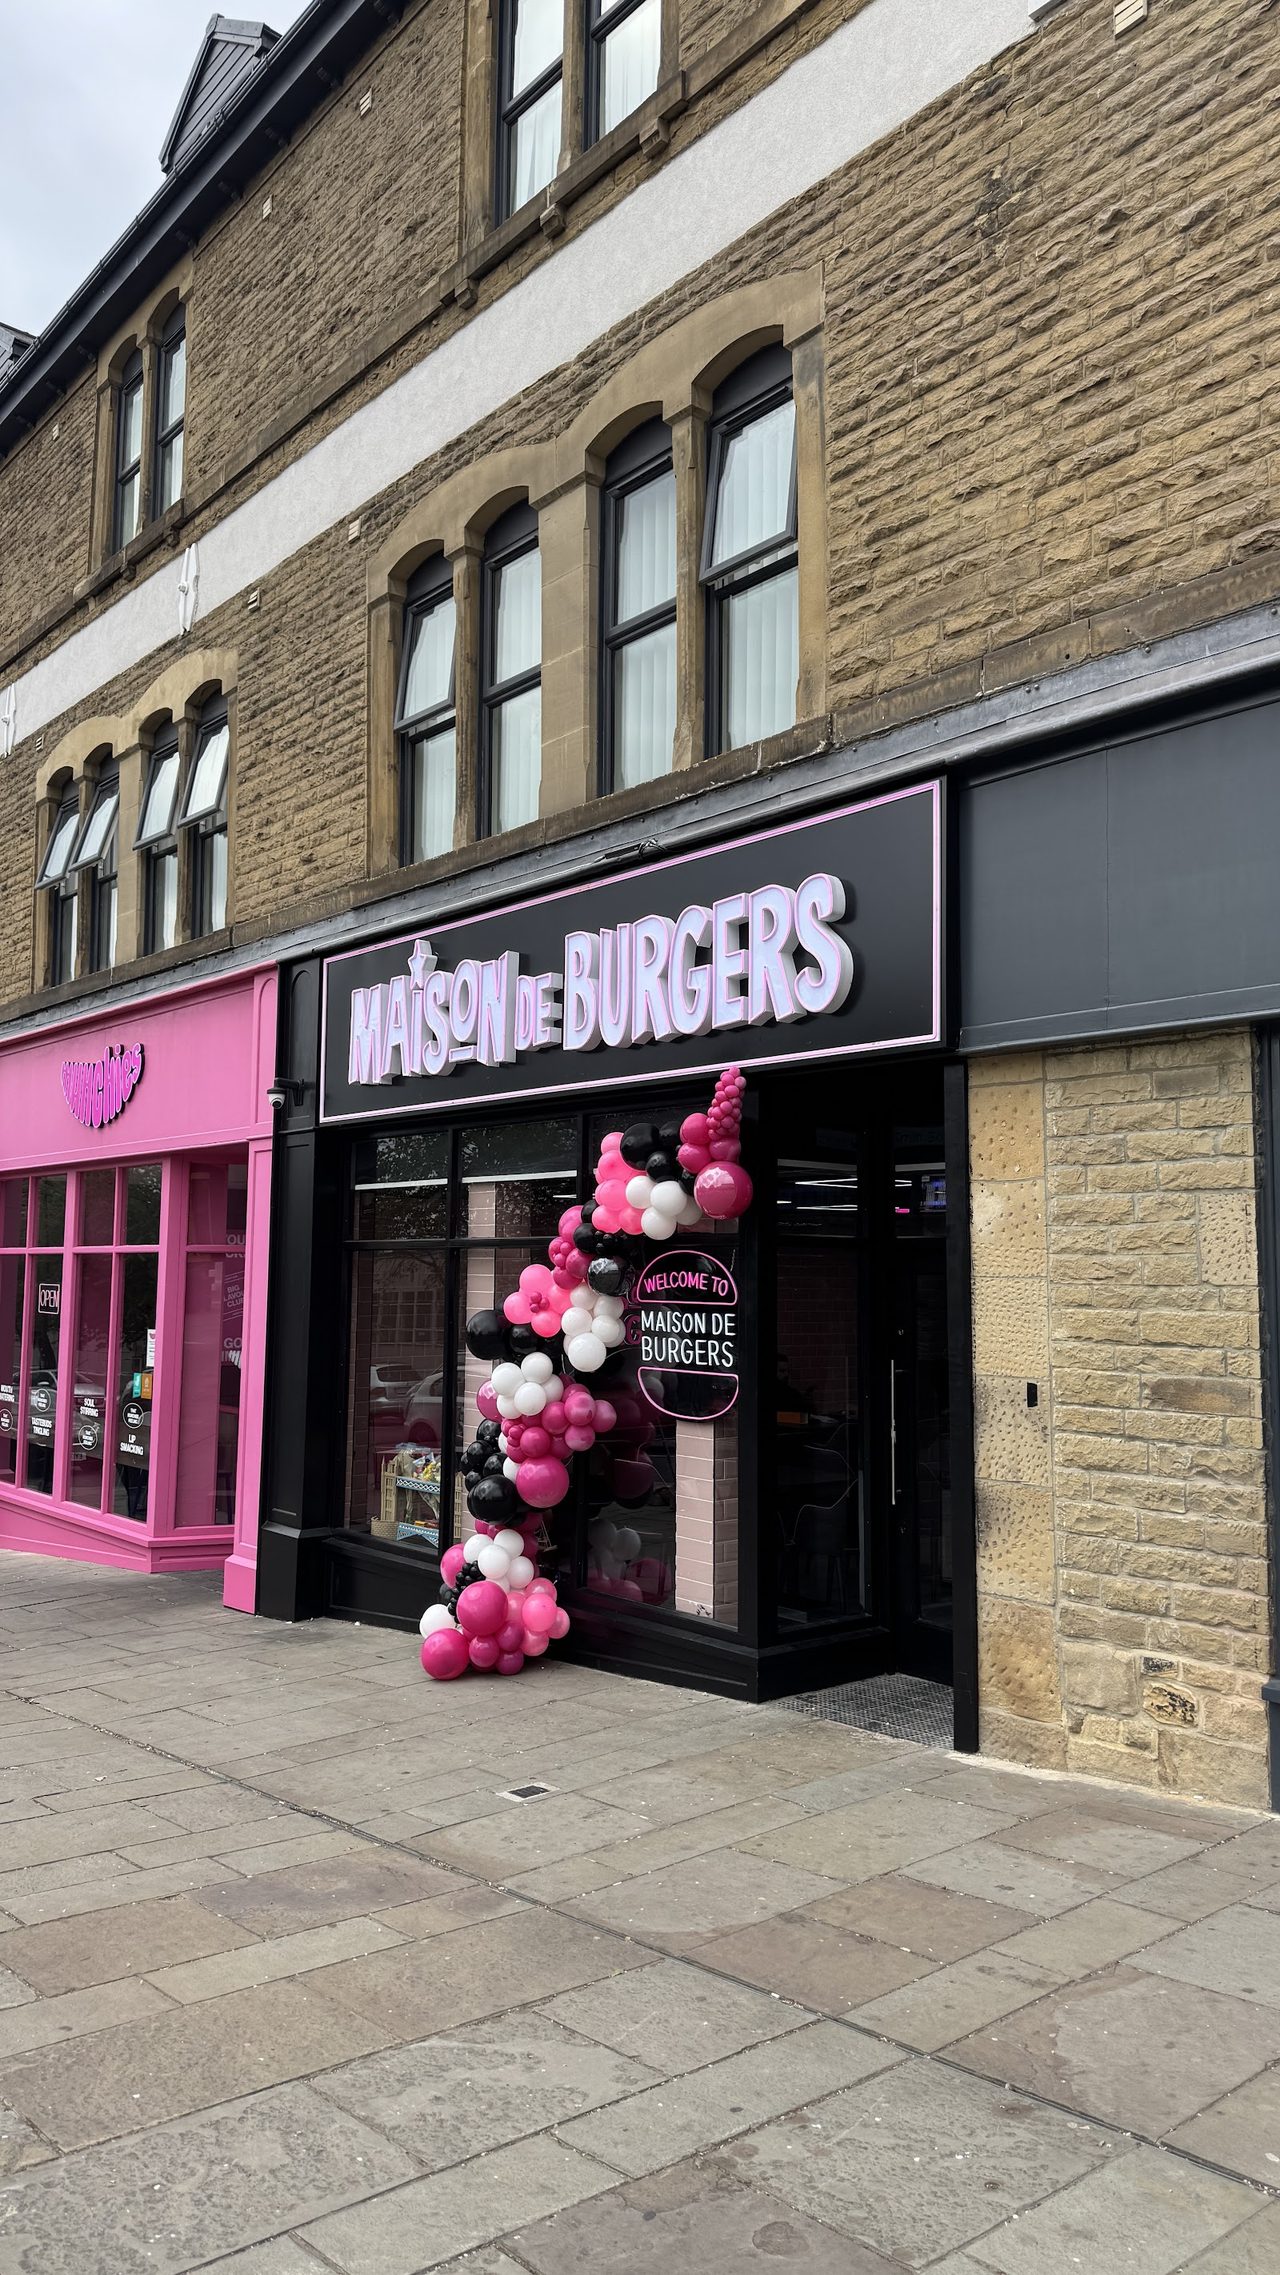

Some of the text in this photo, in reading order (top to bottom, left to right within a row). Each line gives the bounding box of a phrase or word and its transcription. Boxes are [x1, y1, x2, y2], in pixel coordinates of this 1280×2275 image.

[514, 971, 563, 1051] DE
[562, 873, 854, 1052] BURGERS
[644, 1271, 729, 1296] WELCOME TO
[40, 1289, 59, 1308] OPEN
[641, 1310, 706, 1334] MAISON
[711, 1313, 736, 1336] DE
[641, 1336, 734, 1367] BURGERS
[128, 1434, 137, 1444] LIP
